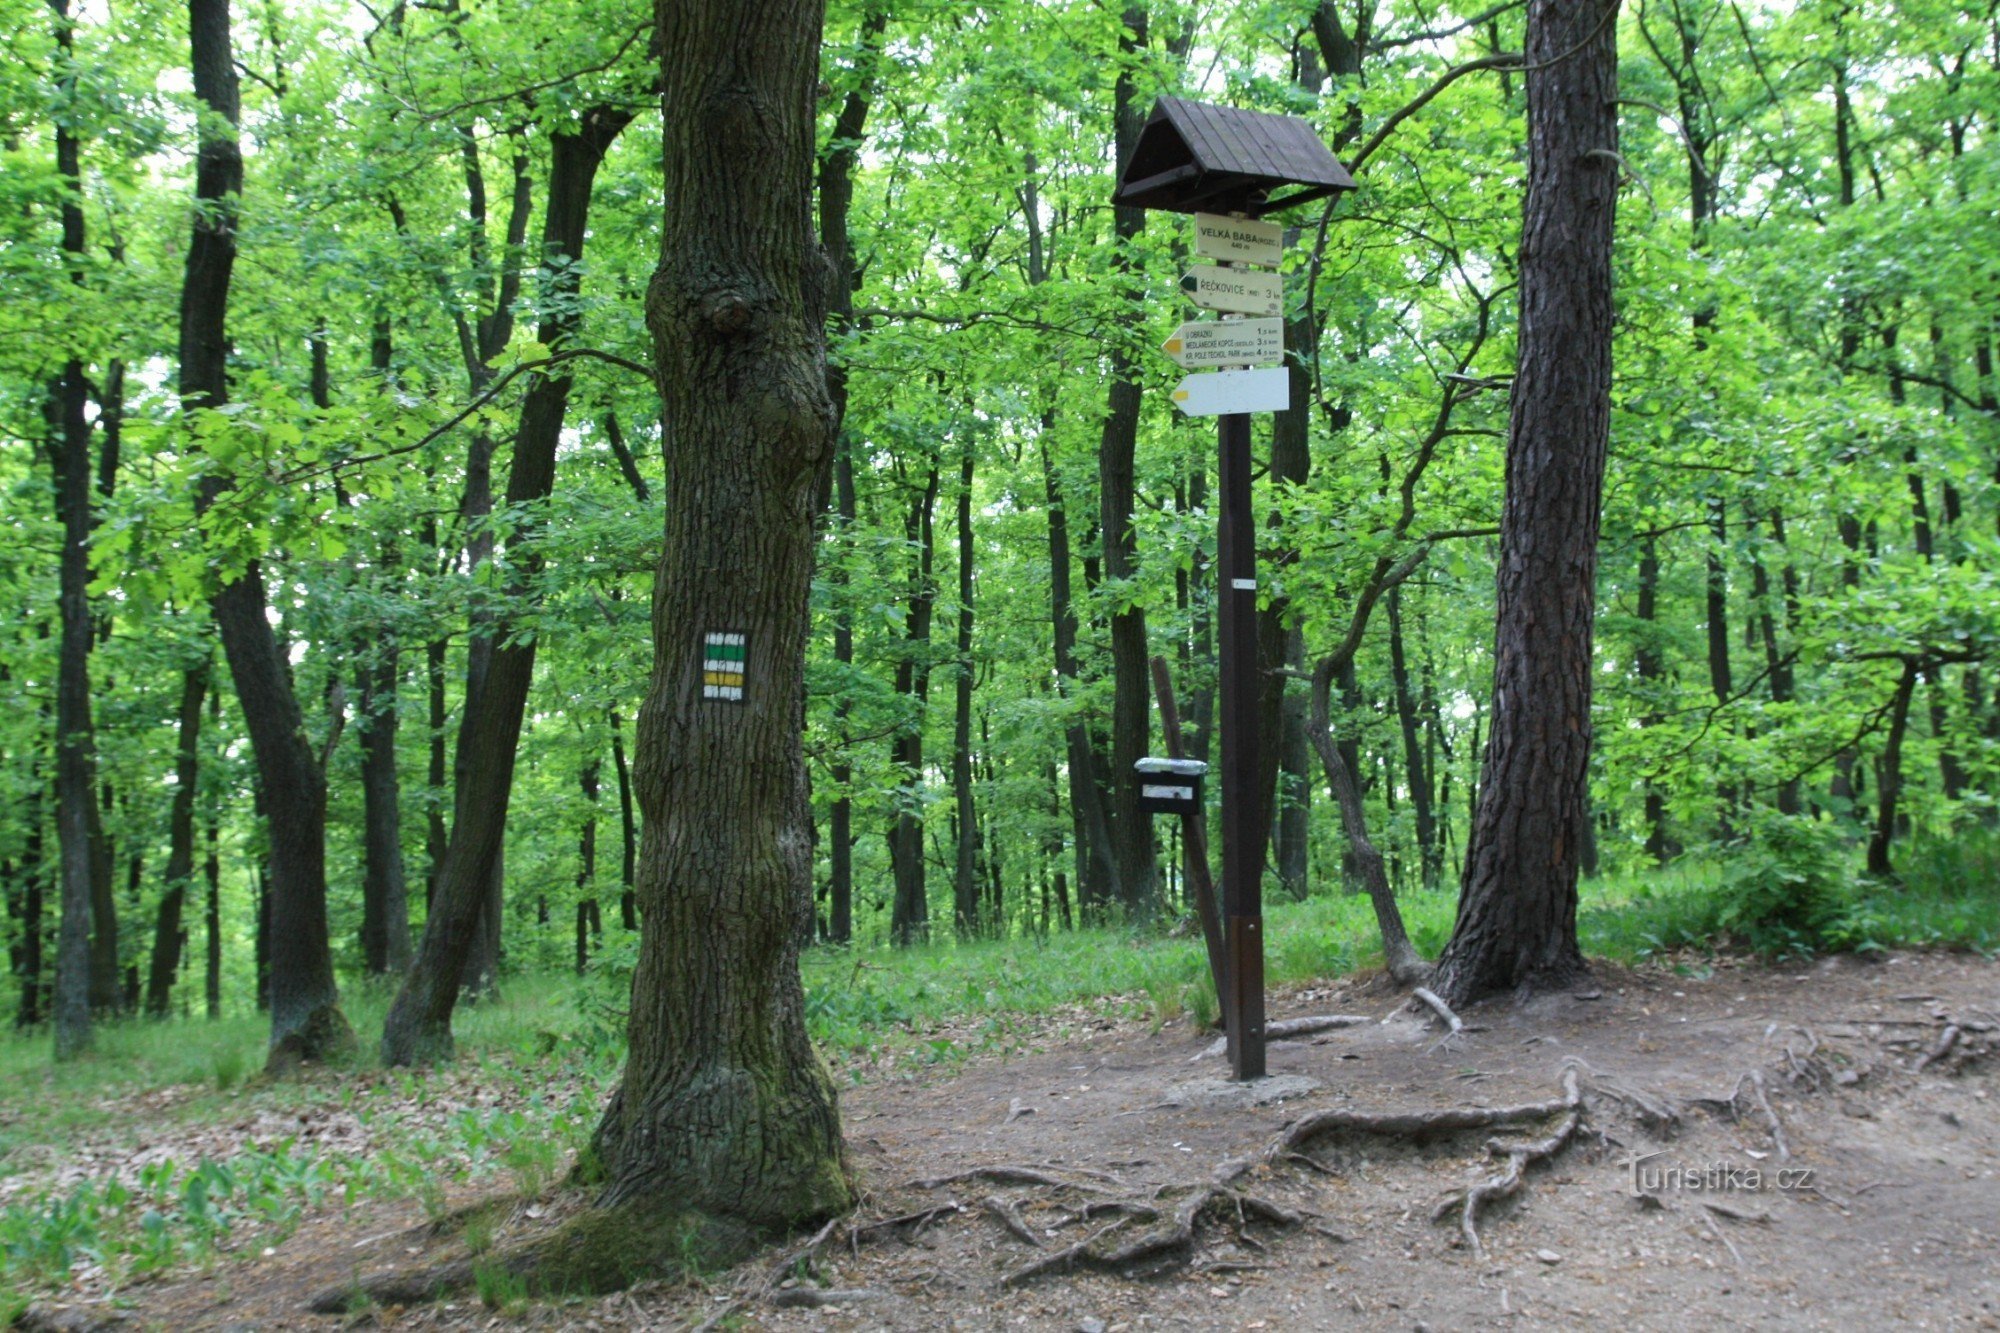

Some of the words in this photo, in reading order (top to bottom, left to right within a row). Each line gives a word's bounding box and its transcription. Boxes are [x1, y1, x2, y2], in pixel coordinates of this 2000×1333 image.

[1233, 232, 1257, 242] BABA
[1200, 279, 1244, 295] ŘEČKOVICE
[1265, 288, 1272, 299] 3
